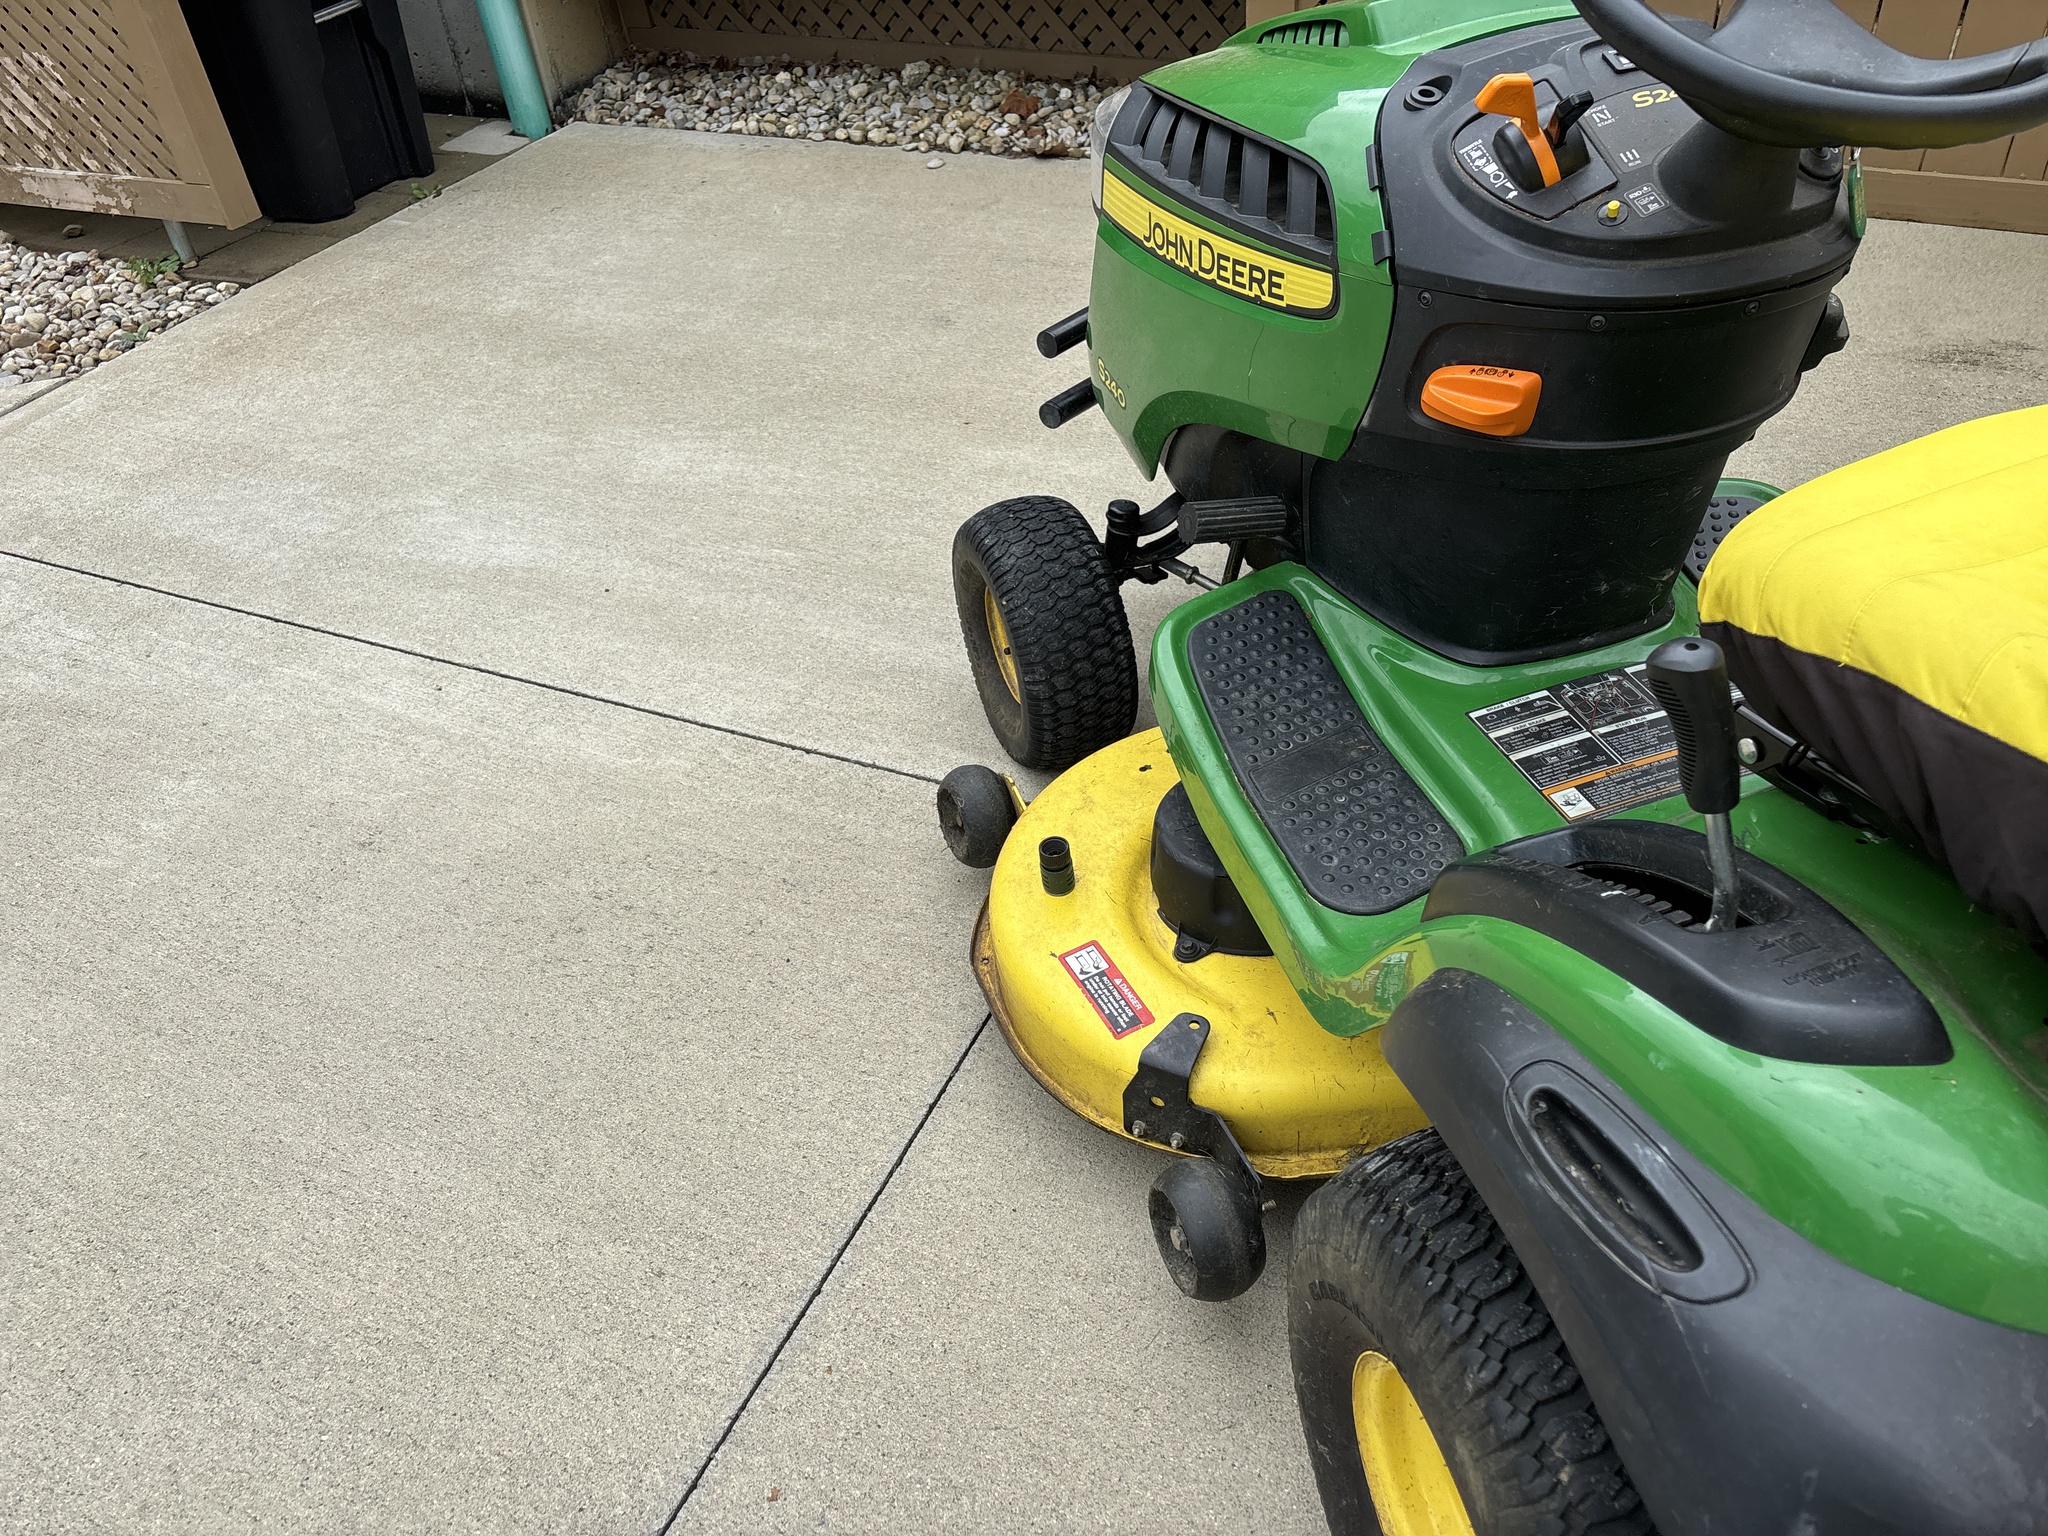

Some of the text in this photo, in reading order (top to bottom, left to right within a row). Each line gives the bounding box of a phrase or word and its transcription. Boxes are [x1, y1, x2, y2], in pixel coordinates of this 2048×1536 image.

[1632, 89, 1678, 108] S2
[1597, 118, 1616, 127] START
[1143, 211, 1285, 302] JOHN DEERE
[1098, 357, 1126, 409] S240
[1486, 704, 1503, 712] BRAKE
[1509, 696, 1529, 705] CLUTCH
[1615, 720, 1632, 728] START
[1611, 763, 1636, 774] WARNING
[1082, 980, 1095, 994] engine
[1095, 997, 1109, 1014] running
[1088, 977, 1099, 989] under
[1116, 1015, 1127, 1028] when
[1101, 975, 1134, 1017] ROTATING BLADE
[1102, 988, 1110, 996] put
[1108, 995, 1120, 1008] hands
[1119, 982, 1142, 1010] DANGER
